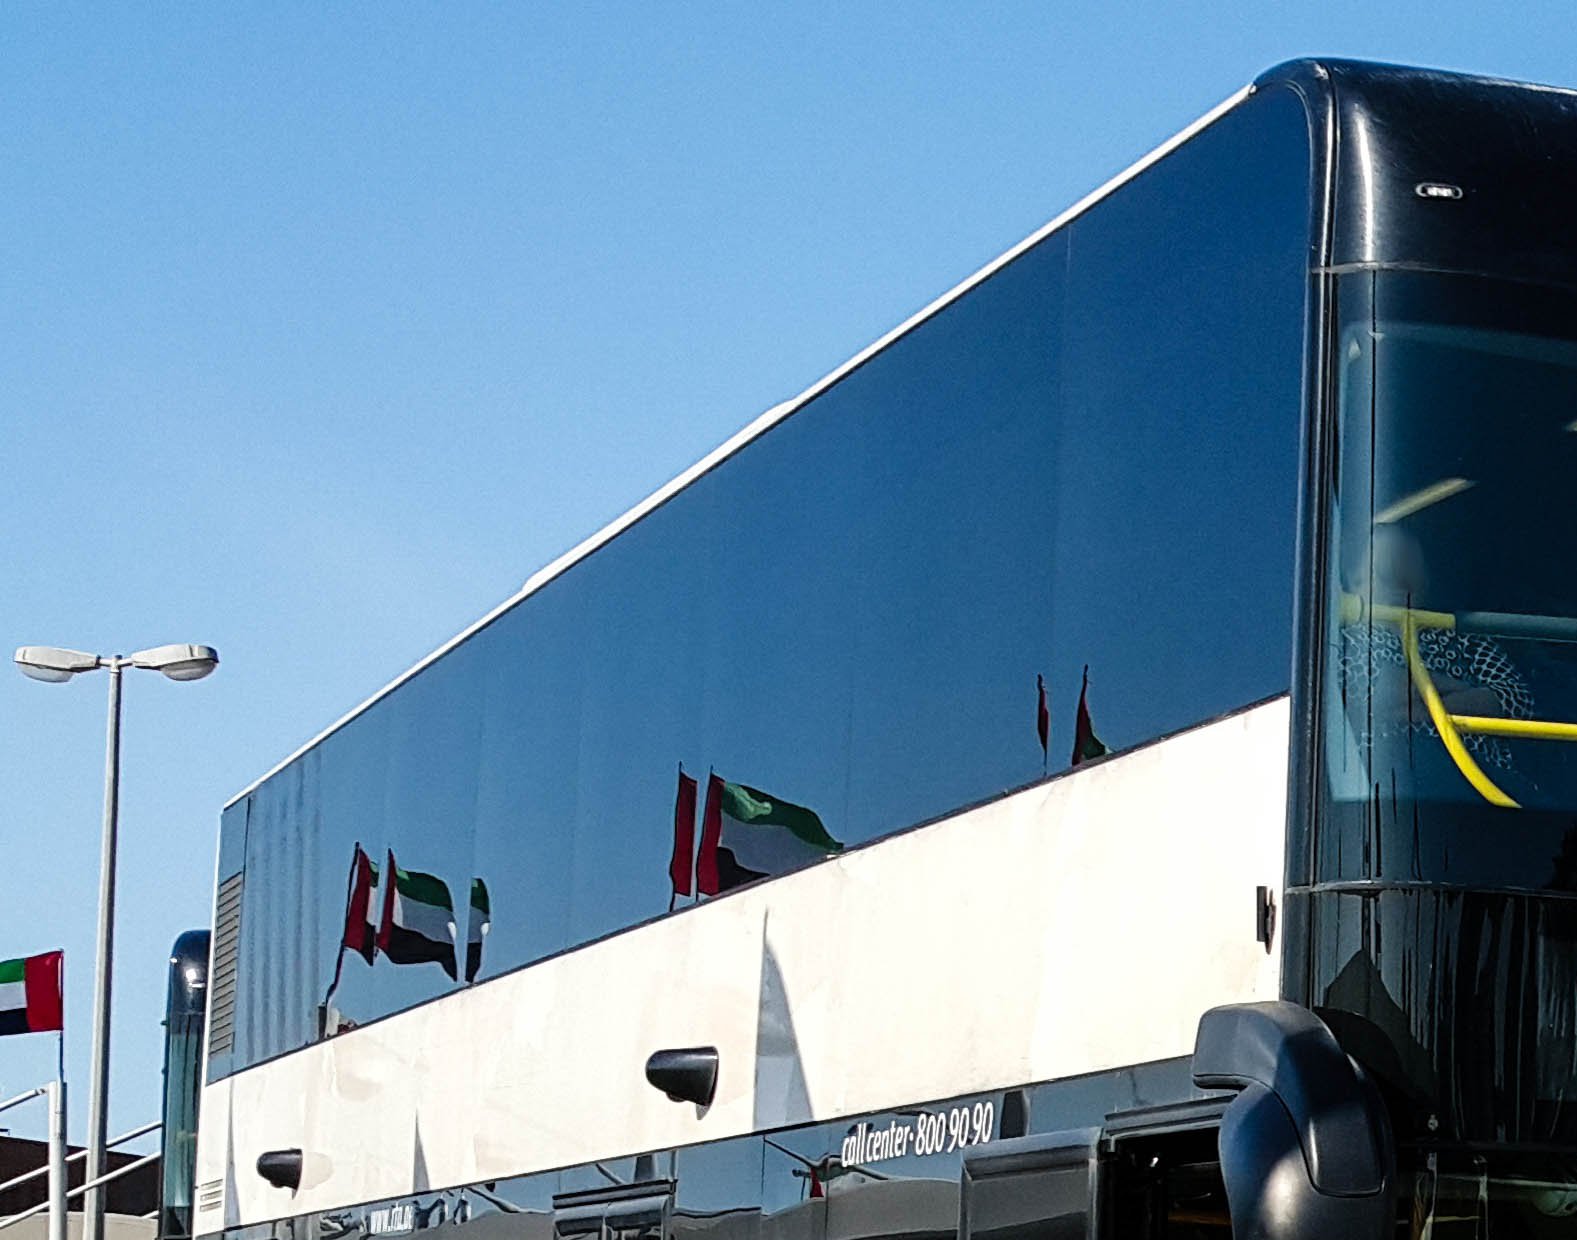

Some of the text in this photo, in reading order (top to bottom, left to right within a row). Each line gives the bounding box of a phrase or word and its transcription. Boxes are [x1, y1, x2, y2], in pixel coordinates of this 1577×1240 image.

[841, 1122, 867, 1168] call
[915, 1113, 947, 1156] 800
[948, 1107, 970, 1153] 90
[972, 1101, 994, 1146] 90
